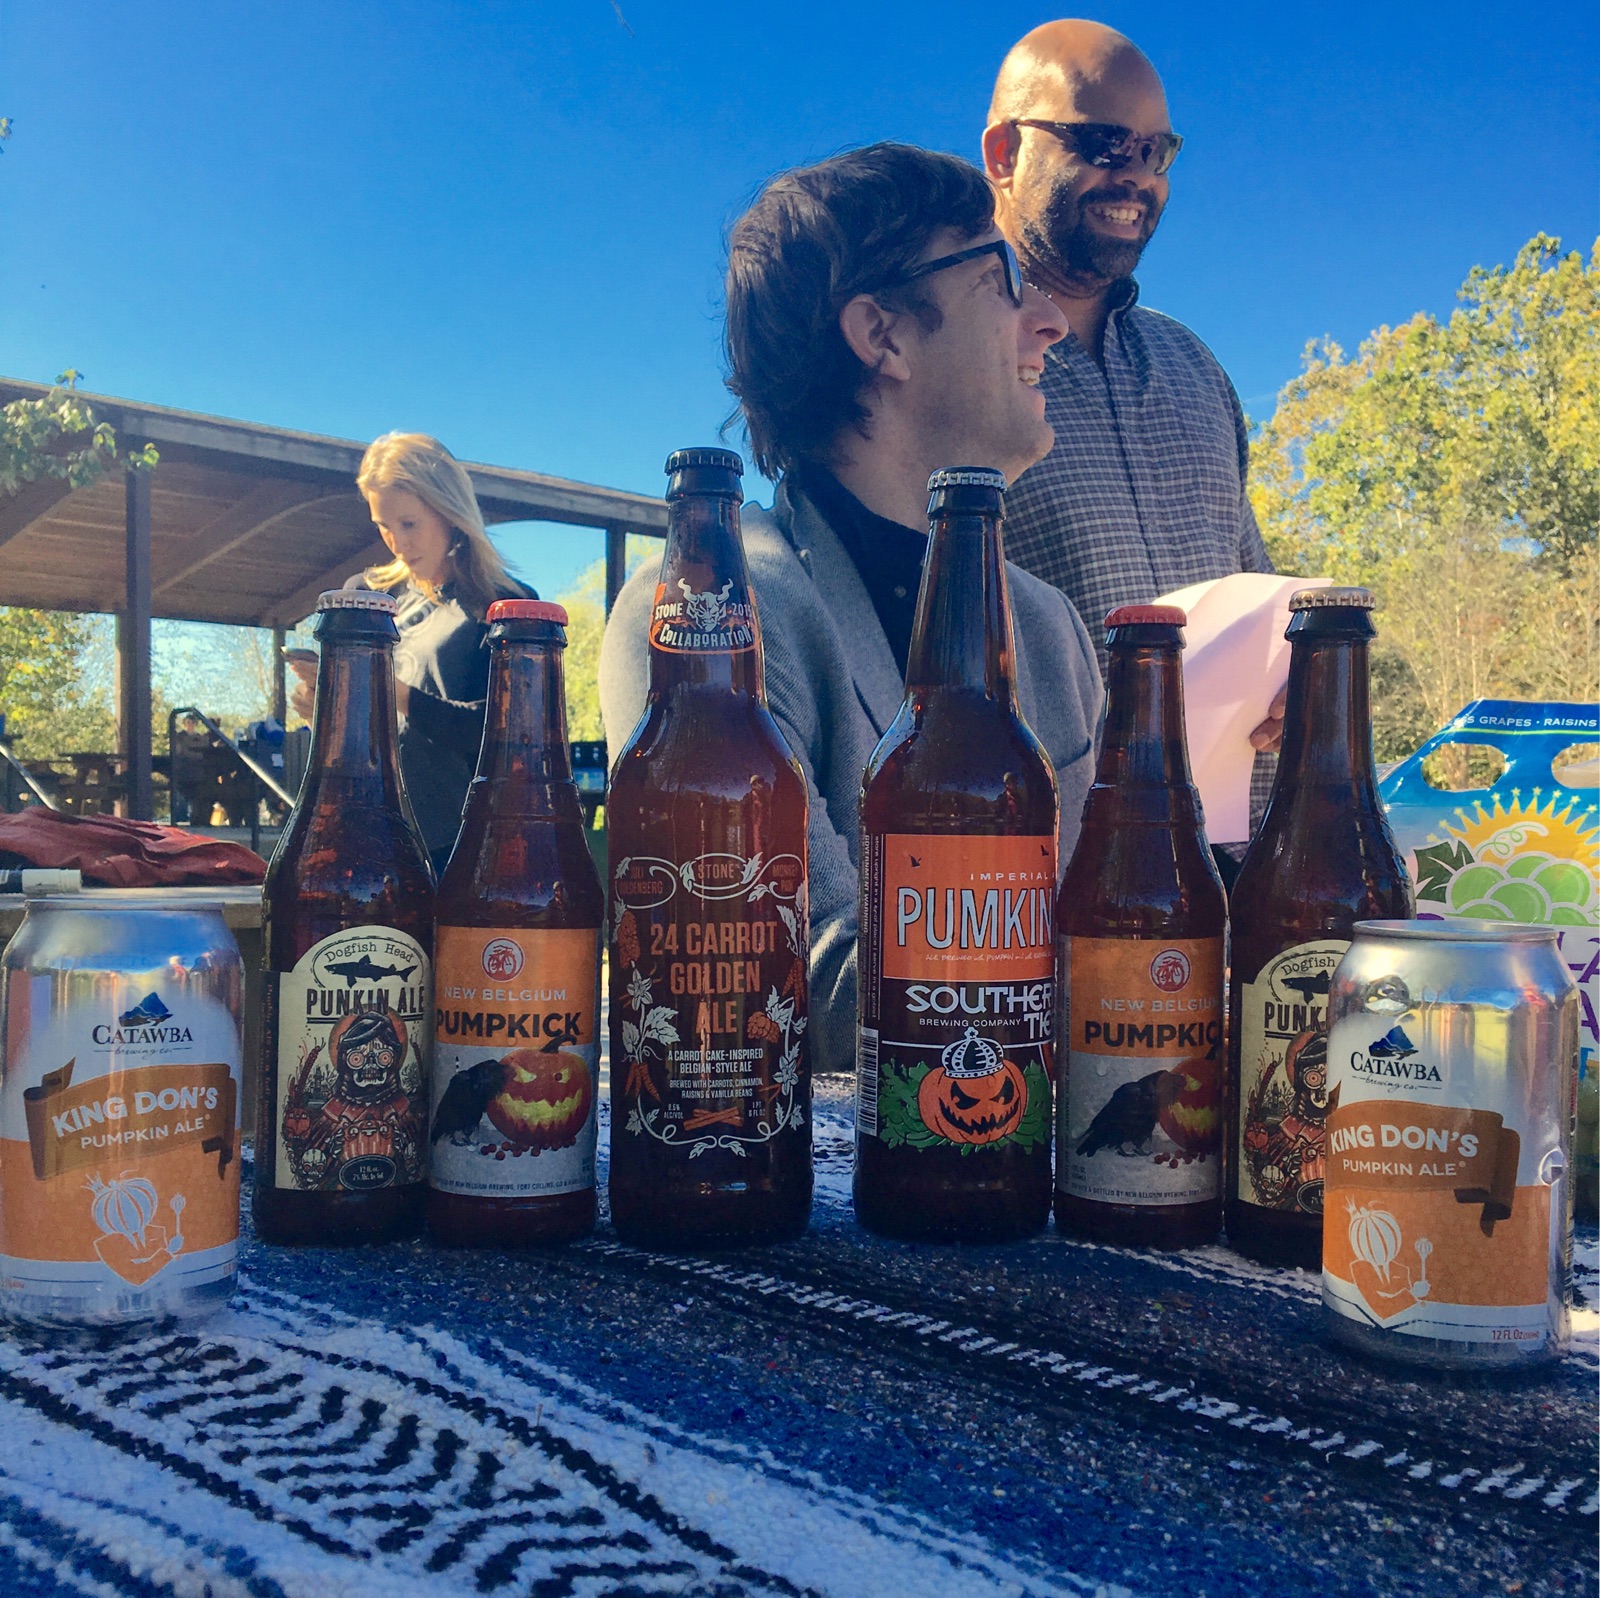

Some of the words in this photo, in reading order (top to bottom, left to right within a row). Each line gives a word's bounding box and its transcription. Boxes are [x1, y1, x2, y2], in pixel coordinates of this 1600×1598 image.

[655, 602, 684, 620] STONE
[659, 623, 753, 647] COLLABORATION
[1479, 716, 1532, 727] GRAPES
[1543, 718, 1598, 727] RAISINS
[697, 863, 735, 879] STONE
[970, 872, 1050, 881] IMPERIAL
[896, 886, 1054, 950] PUMKIN
[650, 923, 679, 956] 24
[686, 921, 778, 955] CARROT
[324, 941, 377, 962] Dogfish
[384, 943, 414, 963] Head
[1281, 956, 1336, 976] Dogfish
[670, 961, 761, 995] GOLDEN
[306, 988, 390, 1016] PUNKIN
[397, 986, 425, 1014] ALE
[444, 987, 477, 1000] NEW
[482, 988, 567, 1001] BELGIUM
[905, 982, 1052, 1014] SOUTHER
[1101, 998, 1145, 1012] NEW
[435, 1009, 583, 1038] PUMPKICK
[695, 1001, 737, 1034] ALE
[919, 1018, 969, 1027] BREWING
[972, 1018, 1021, 1028] COMPANY
[92, 1024, 193, 1045] CATAWBA
[114, 1046, 157, 1060] brewing
[668, 1050, 673, 1060] A
[674, 1050, 704, 1061] CARROT
[705, 1048, 764, 1061] CAKE-INSPIRED
[680, 1062, 739, 1074] BELGIAN-STYLE
[739, 1061, 753, 1072] ALE
[1350, 1051, 1443, 1082] CATAWBA
[669, 1079, 692, 1088] BREWED
[692, 1079, 707, 1088] WITH
[1365, 1073, 1401, 1093] brewing
[681, 1090, 704, 1099] RAISINS
[705, 1090, 710, 1098] &
[710, 1089, 734, 1098] VANILLA
[735, 1088, 753, 1098] BEANS
[51, 1096, 128, 1138] KING
[134, 1087, 219, 1115] DON'S
[80, 1124, 169, 1150] PUMPKIN
[173, 1117, 204, 1136] ALE
[1330, 1125, 1375, 1155] KING
[1380, 1124, 1479, 1158] DON'S
[1343, 1158, 1413, 1176] PUMPKIN
[1419, 1162, 1457, 1176] ALE
[1492, 1329, 1502, 1341] 12
[1503, 1329, 1511, 1340] FL
